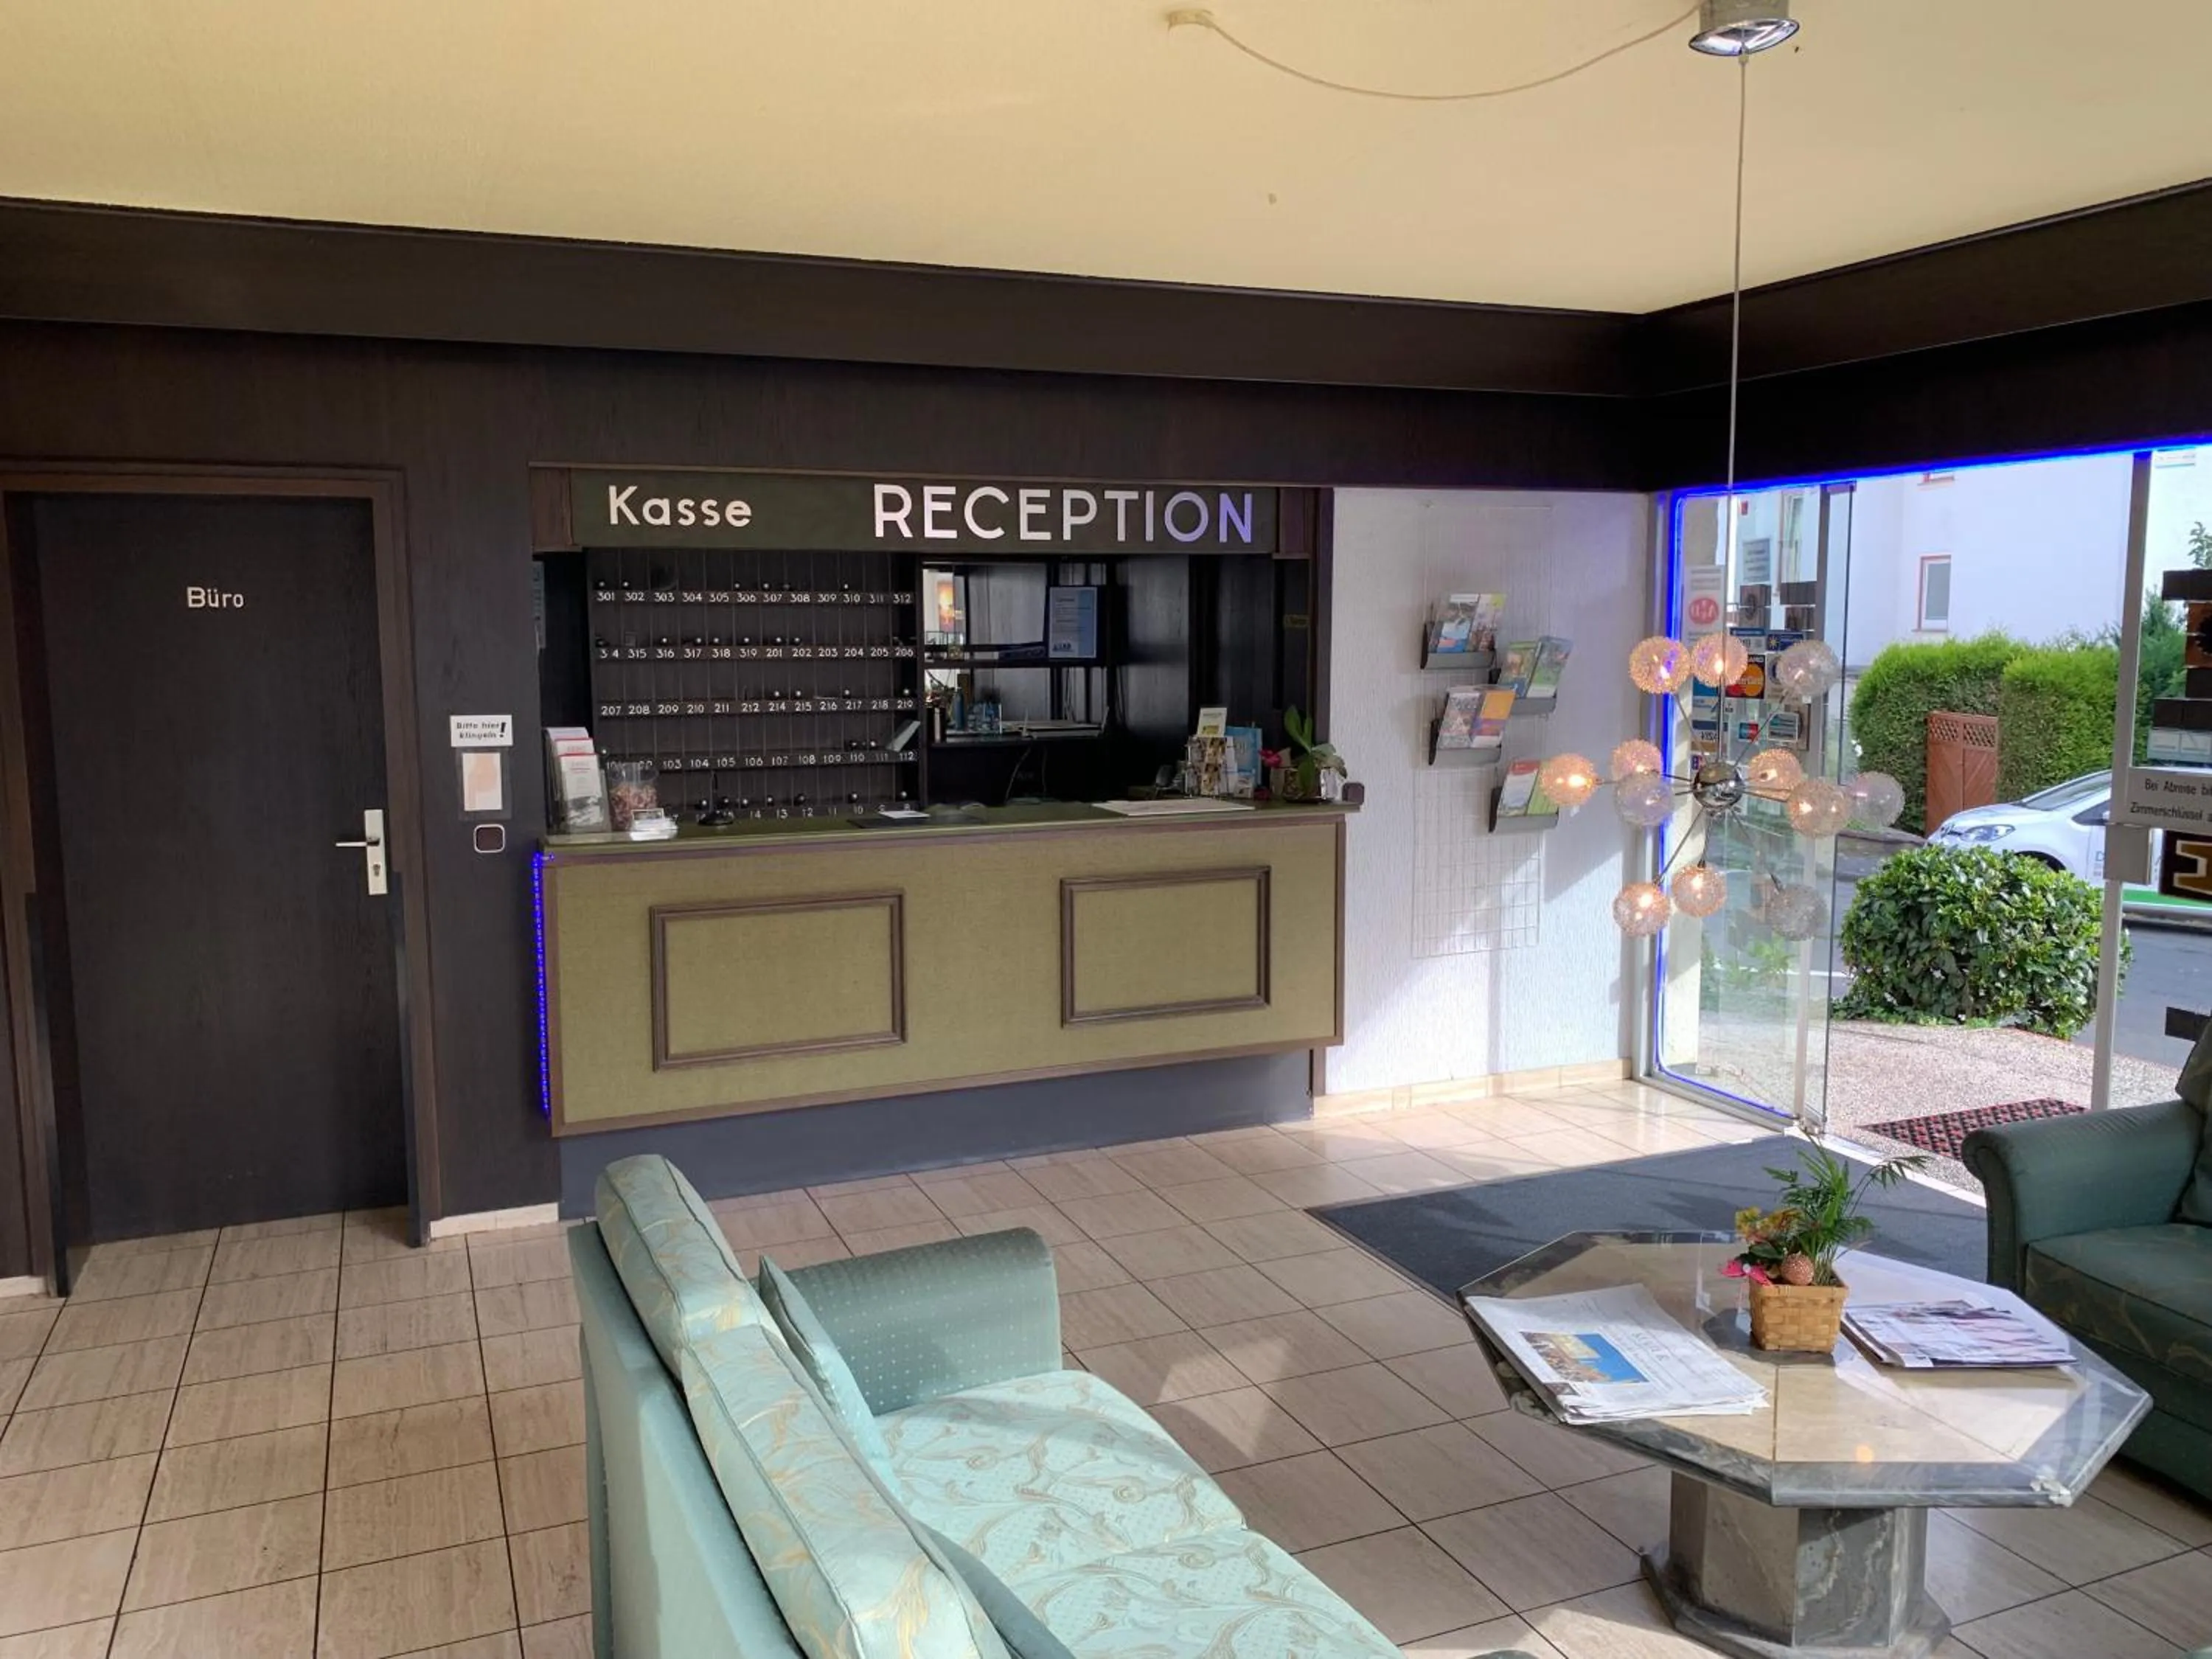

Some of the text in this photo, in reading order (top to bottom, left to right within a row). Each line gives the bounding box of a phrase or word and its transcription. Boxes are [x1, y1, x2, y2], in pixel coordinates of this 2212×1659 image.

[608, 484, 1253, 543] Kasse RECEPTION
[187, 586, 244, 608] Büro
[598, 591, 911, 604] 301 302 303 304 305 306 307 308 309 310 311 312
[601, 649, 619, 658] 34
[627, 648, 647, 658] 315
[656, 648, 675, 658] 316
[684, 648, 702, 658] 317
[712, 648, 731, 658] 318
[740, 648, 757, 658] 319
[766, 648, 782, 658] 201
[792, 647, 812, 658] 202
[818, 647, 838, 658] 203
[844, 647, 864, 657] 204
[870, 647, 889, 657] 205
[601, 706, 622, 716] 207
[628, 704, 650, 715] 208
[658, 704, 679, 714] 209
[687, 703, 705, 714] 210
[714, 703, 729, 713] 211
[741, 702, 759, 712] 212
[768, 701, 786, 712] 214
[794, 701, 812, 712] 215
[820, 700, 838, 711] 216
[845, 700, 862, 710] 217
[872, 700, 888, 710] 218
[663, 759, 682, 769] 103
[691, 759, 709, 768] 104
[717, 757, 736, 768] 105
[745, 757, 763, 766] 106
[799, 754, 816, 765] 108
[823, 754, 841, 764] 109
[850, 752, 865, 762] 110
[2145, 778, 2160, 791] Bei
